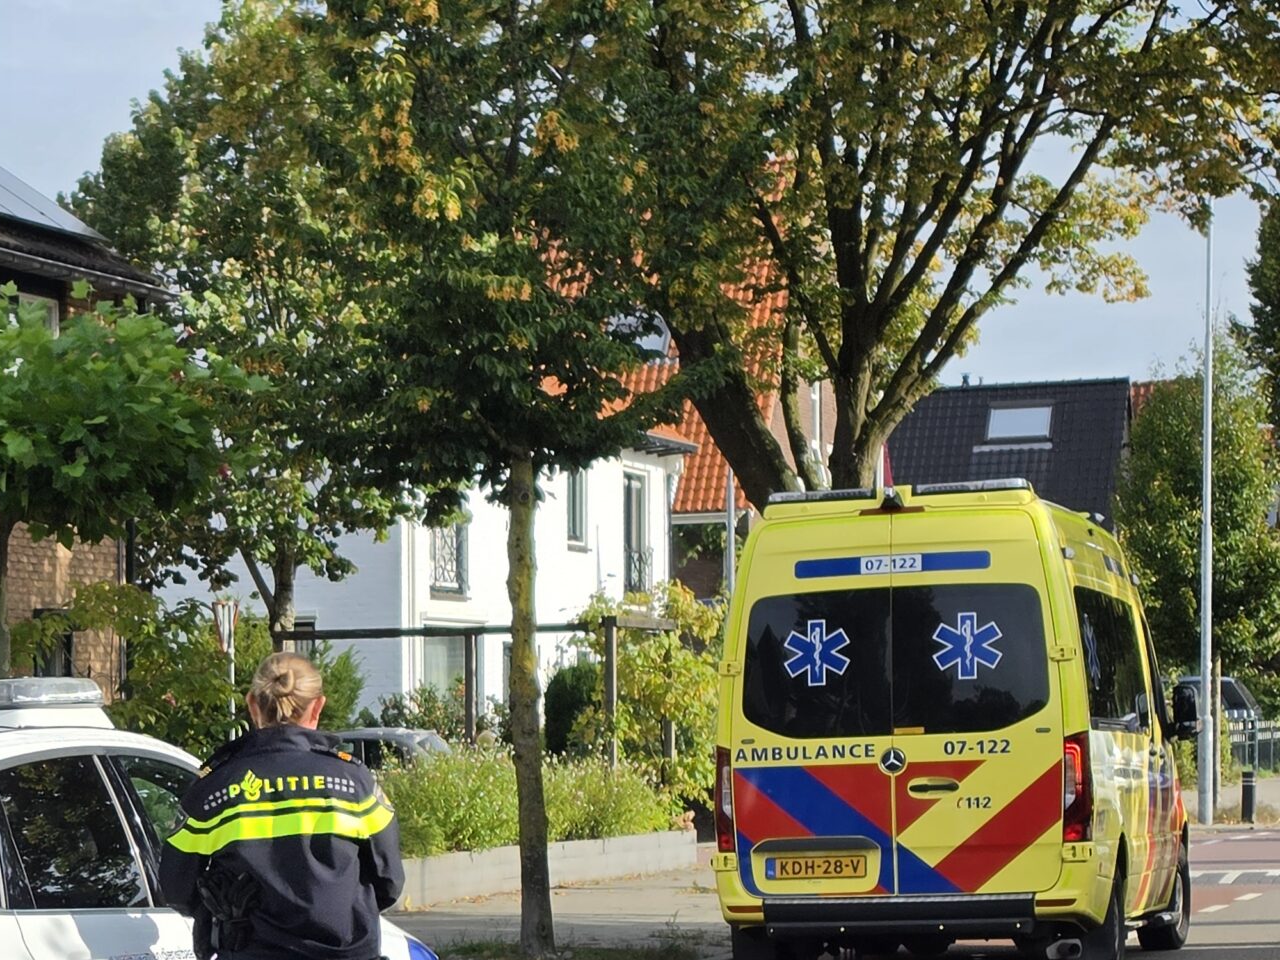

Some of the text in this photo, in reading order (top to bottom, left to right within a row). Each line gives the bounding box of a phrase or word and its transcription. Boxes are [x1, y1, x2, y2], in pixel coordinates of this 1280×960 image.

[865, 557, 917, 571] 07-122
[735, 744, 876, 762] AMBULANCE
[944, 739, 1011, 755] 07-122
[780, 859, 860, 876] KDH-28-V
